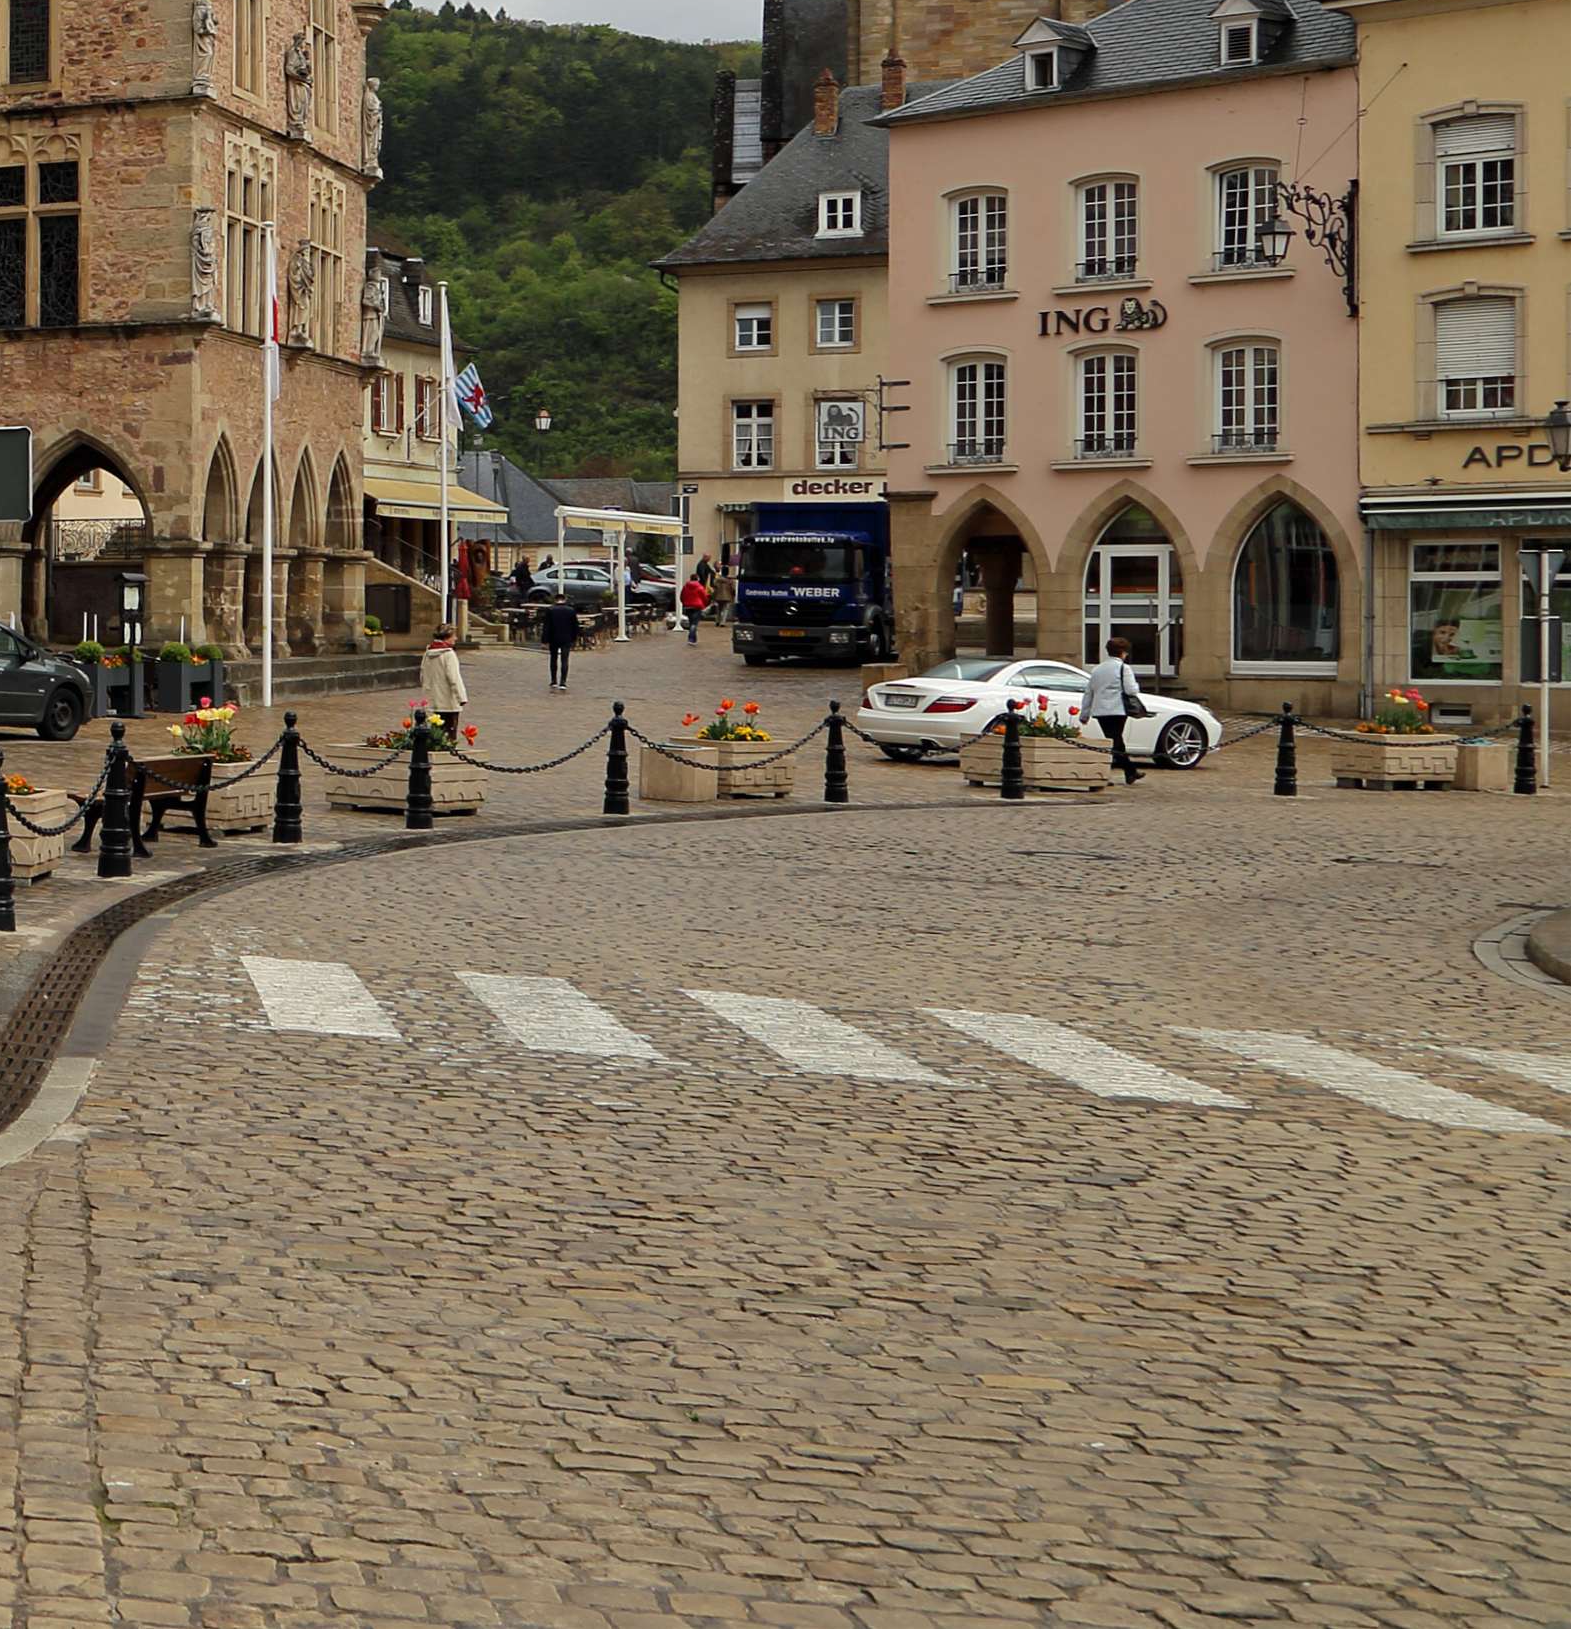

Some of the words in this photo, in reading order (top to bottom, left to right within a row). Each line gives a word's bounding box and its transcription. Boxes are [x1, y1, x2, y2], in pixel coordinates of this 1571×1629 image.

[1038, 307, 1111, 336] ING
[823, 427, 859, 439] ING
[792, 479, 873, 495] decker
[792, 587, 840, 598] WEBER
